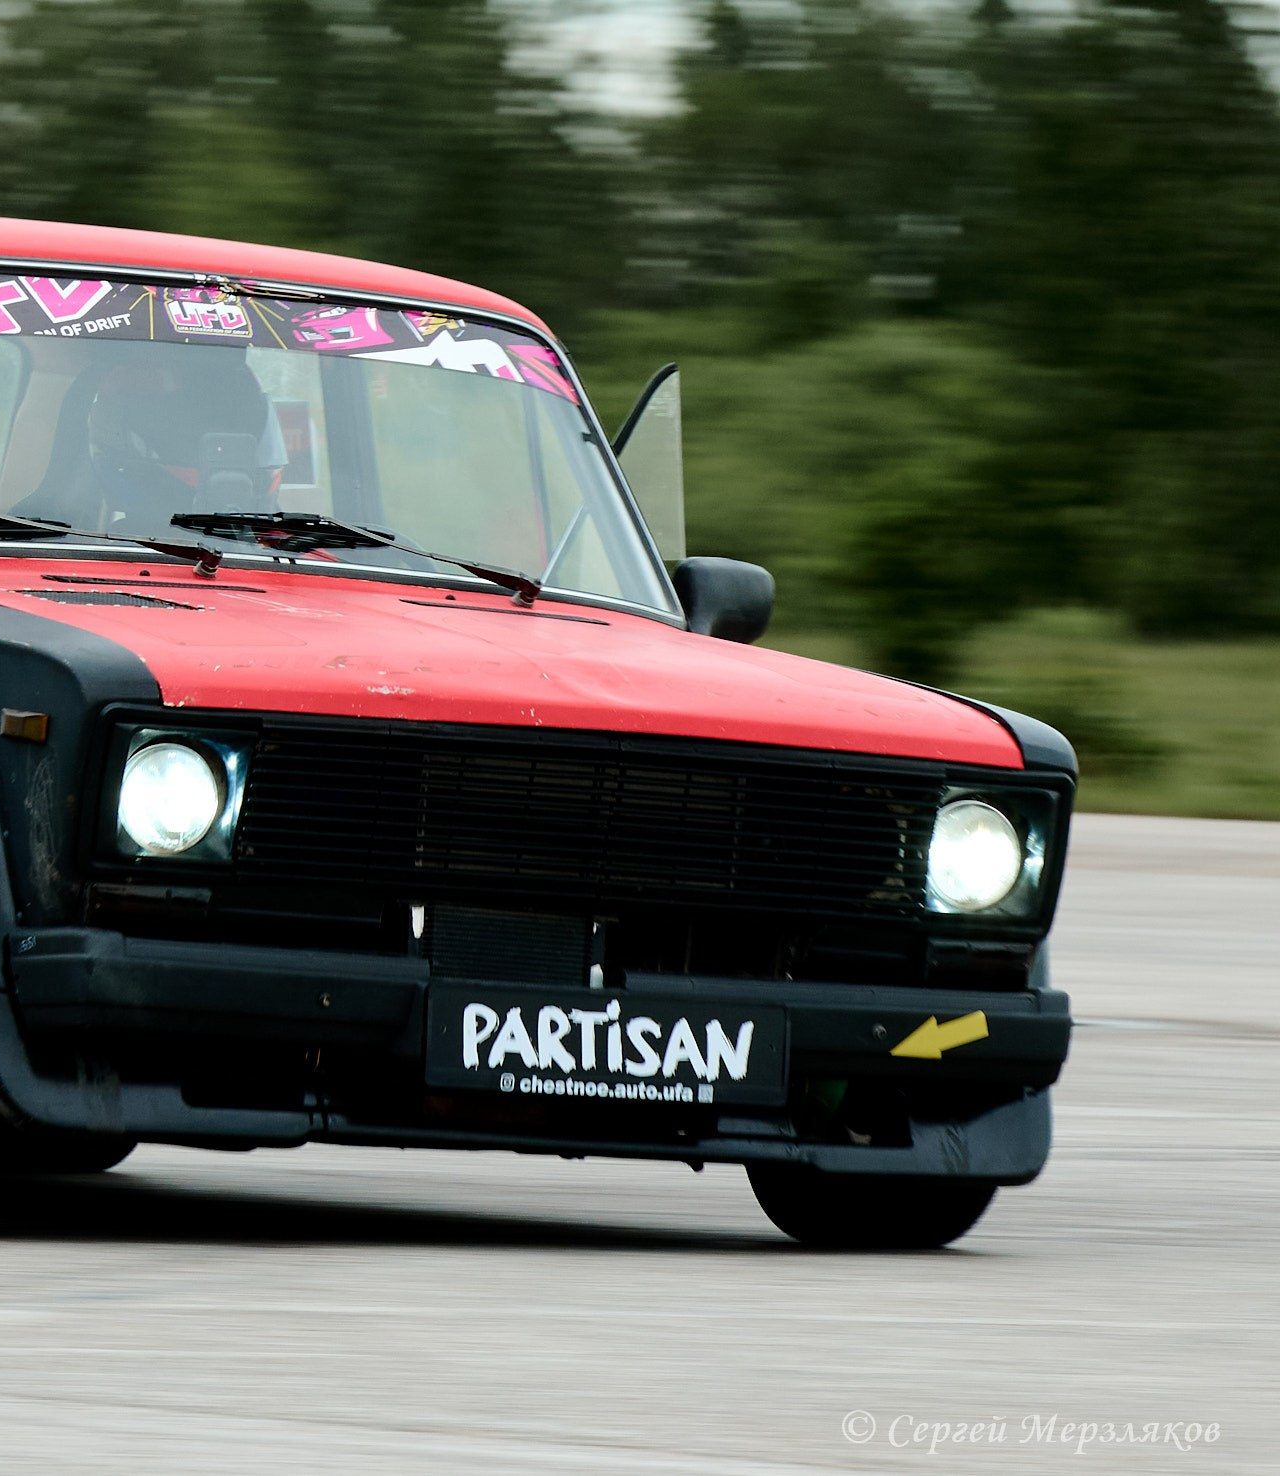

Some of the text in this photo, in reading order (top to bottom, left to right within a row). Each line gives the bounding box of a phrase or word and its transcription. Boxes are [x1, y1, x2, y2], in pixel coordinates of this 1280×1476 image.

[60, 323, 82, 337] OF
[84, 313, 131, 334] DRIFT
[519, 1074, 694, 1103] chestnoe.auto.ufa
